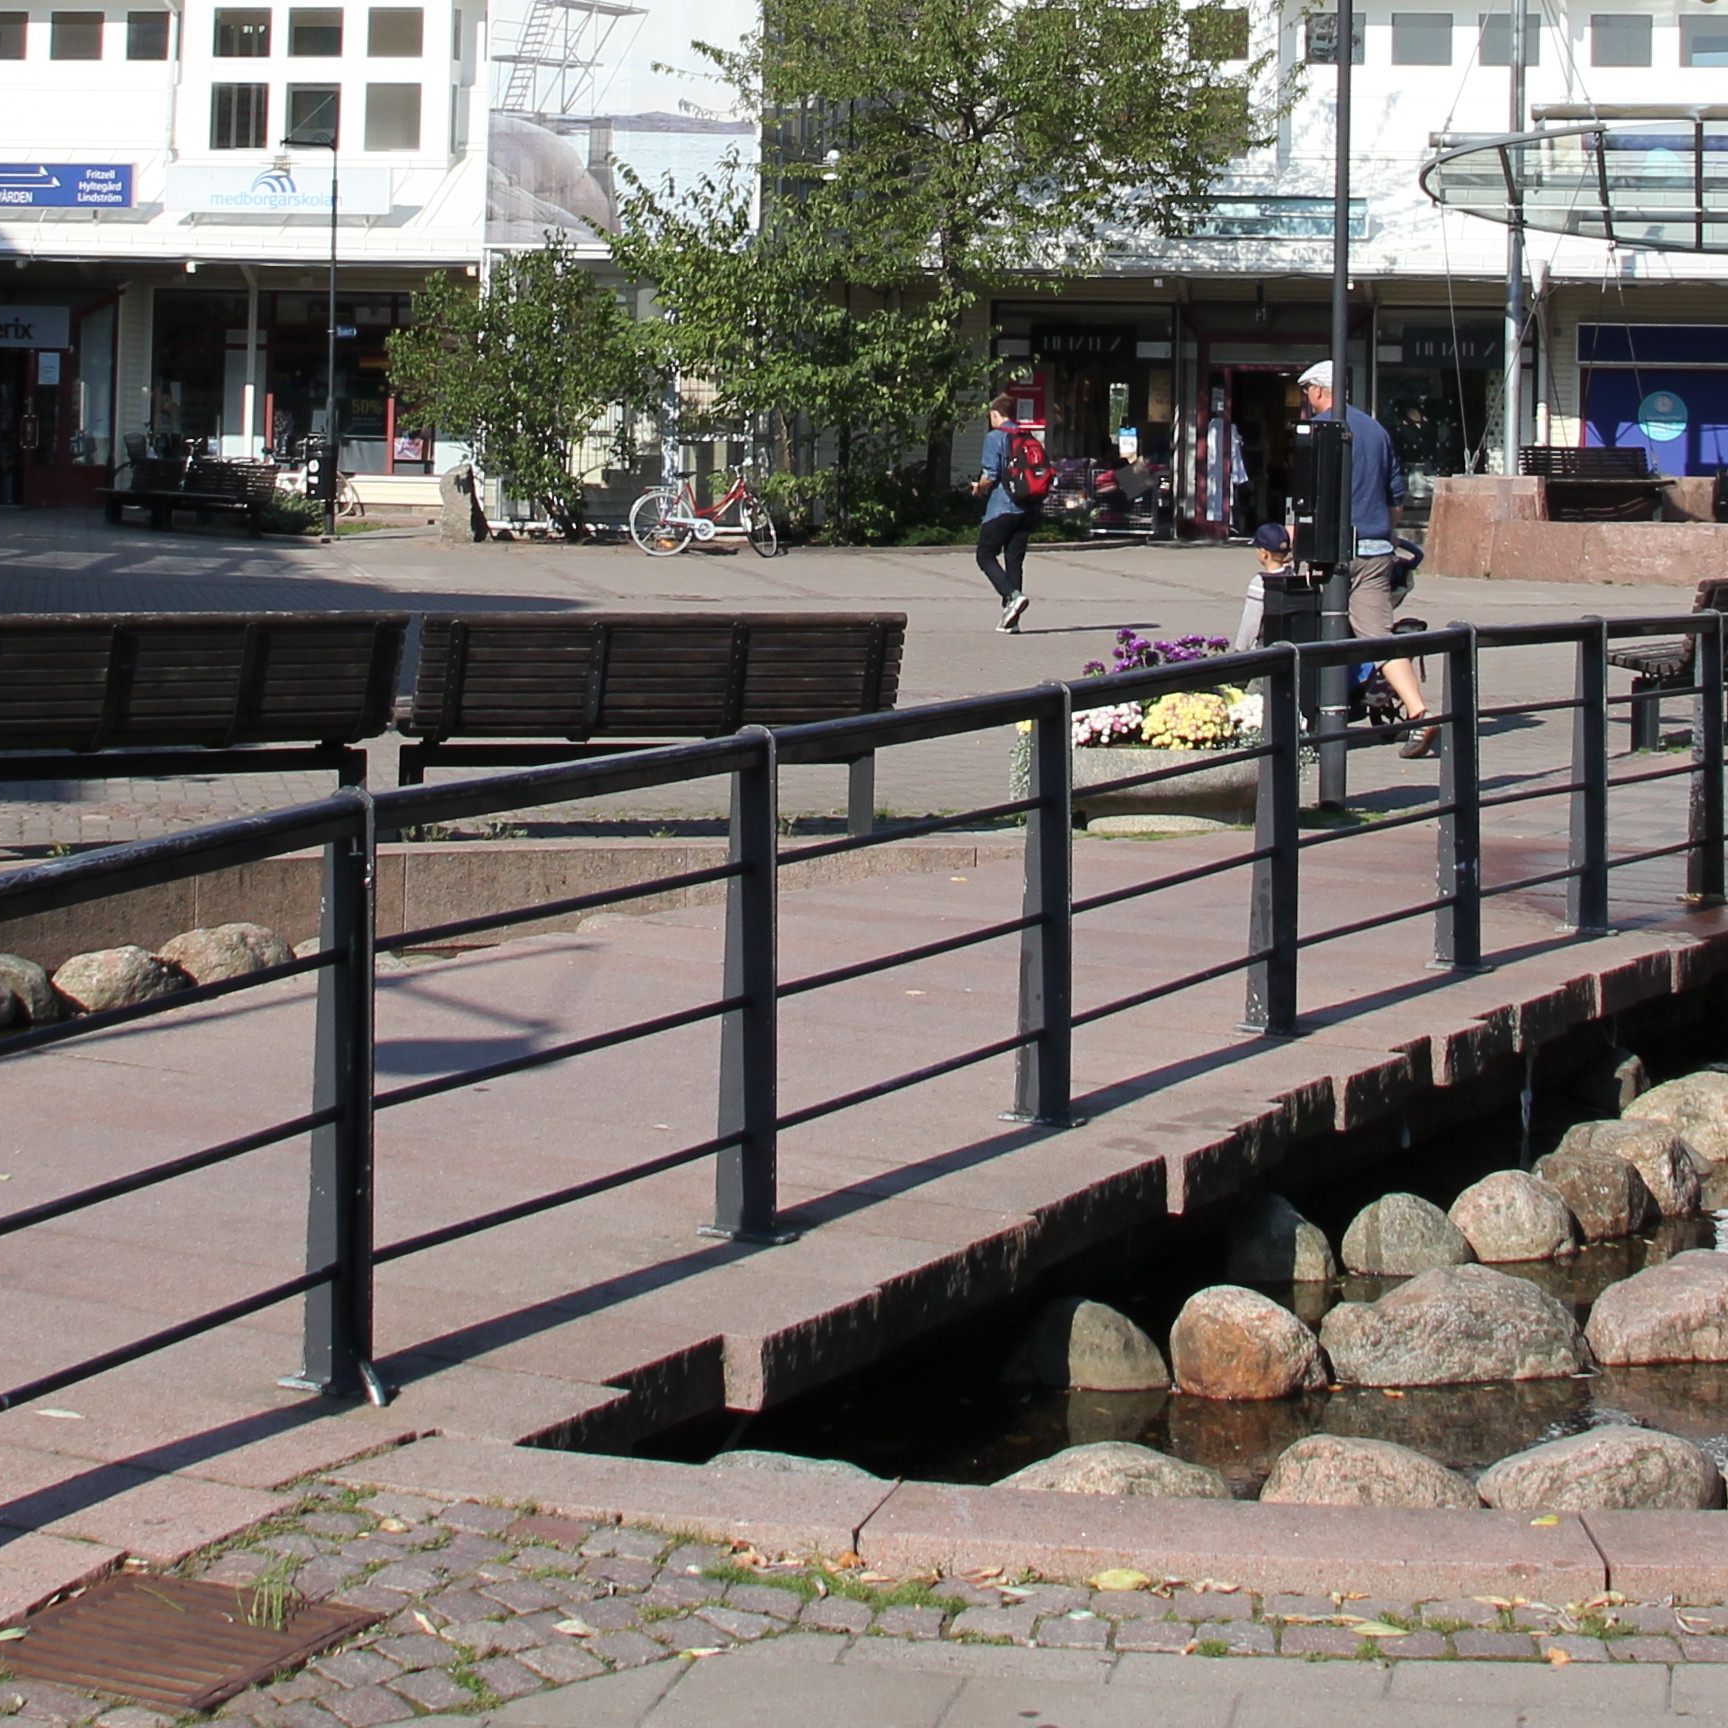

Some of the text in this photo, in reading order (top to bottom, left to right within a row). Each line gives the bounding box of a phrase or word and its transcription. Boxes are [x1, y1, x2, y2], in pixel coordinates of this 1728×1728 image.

[86, 169, 115, 179] Fritzell
[79, 181, 123, 192] Hyltegård
[77, 192, 123, 202] Lindström
[352, 399, 382, 415] 50%
